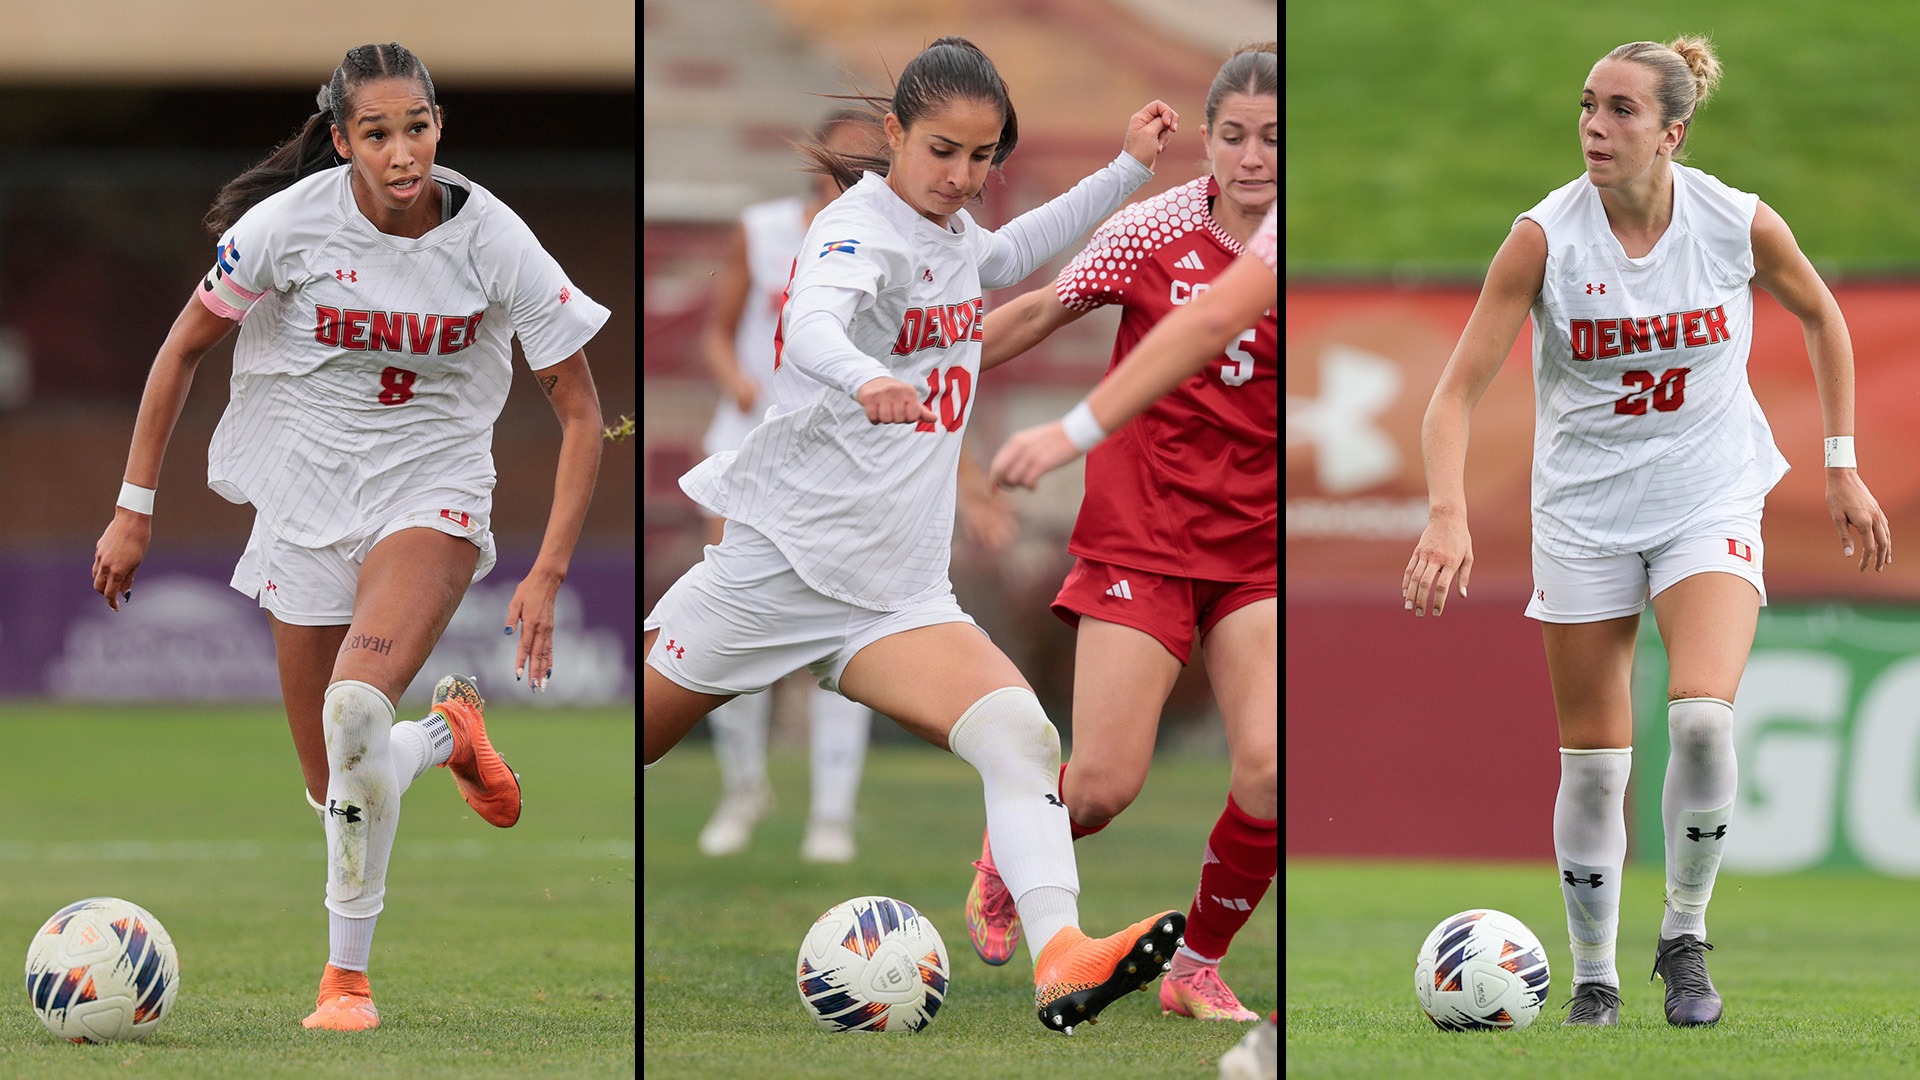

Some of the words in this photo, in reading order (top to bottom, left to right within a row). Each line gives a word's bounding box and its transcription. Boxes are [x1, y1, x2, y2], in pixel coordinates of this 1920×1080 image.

[890, 297, 982, 356] DENVE
[1569, 304, 1731, 362] DENVER
[377, 365, 418, 407] 8
[1219, 328, 1257, 387] 5
[914, 365, 972, 434] 10
[1614, 366, 1692, 416] 20
[341, 633, 394, 656] HEART
